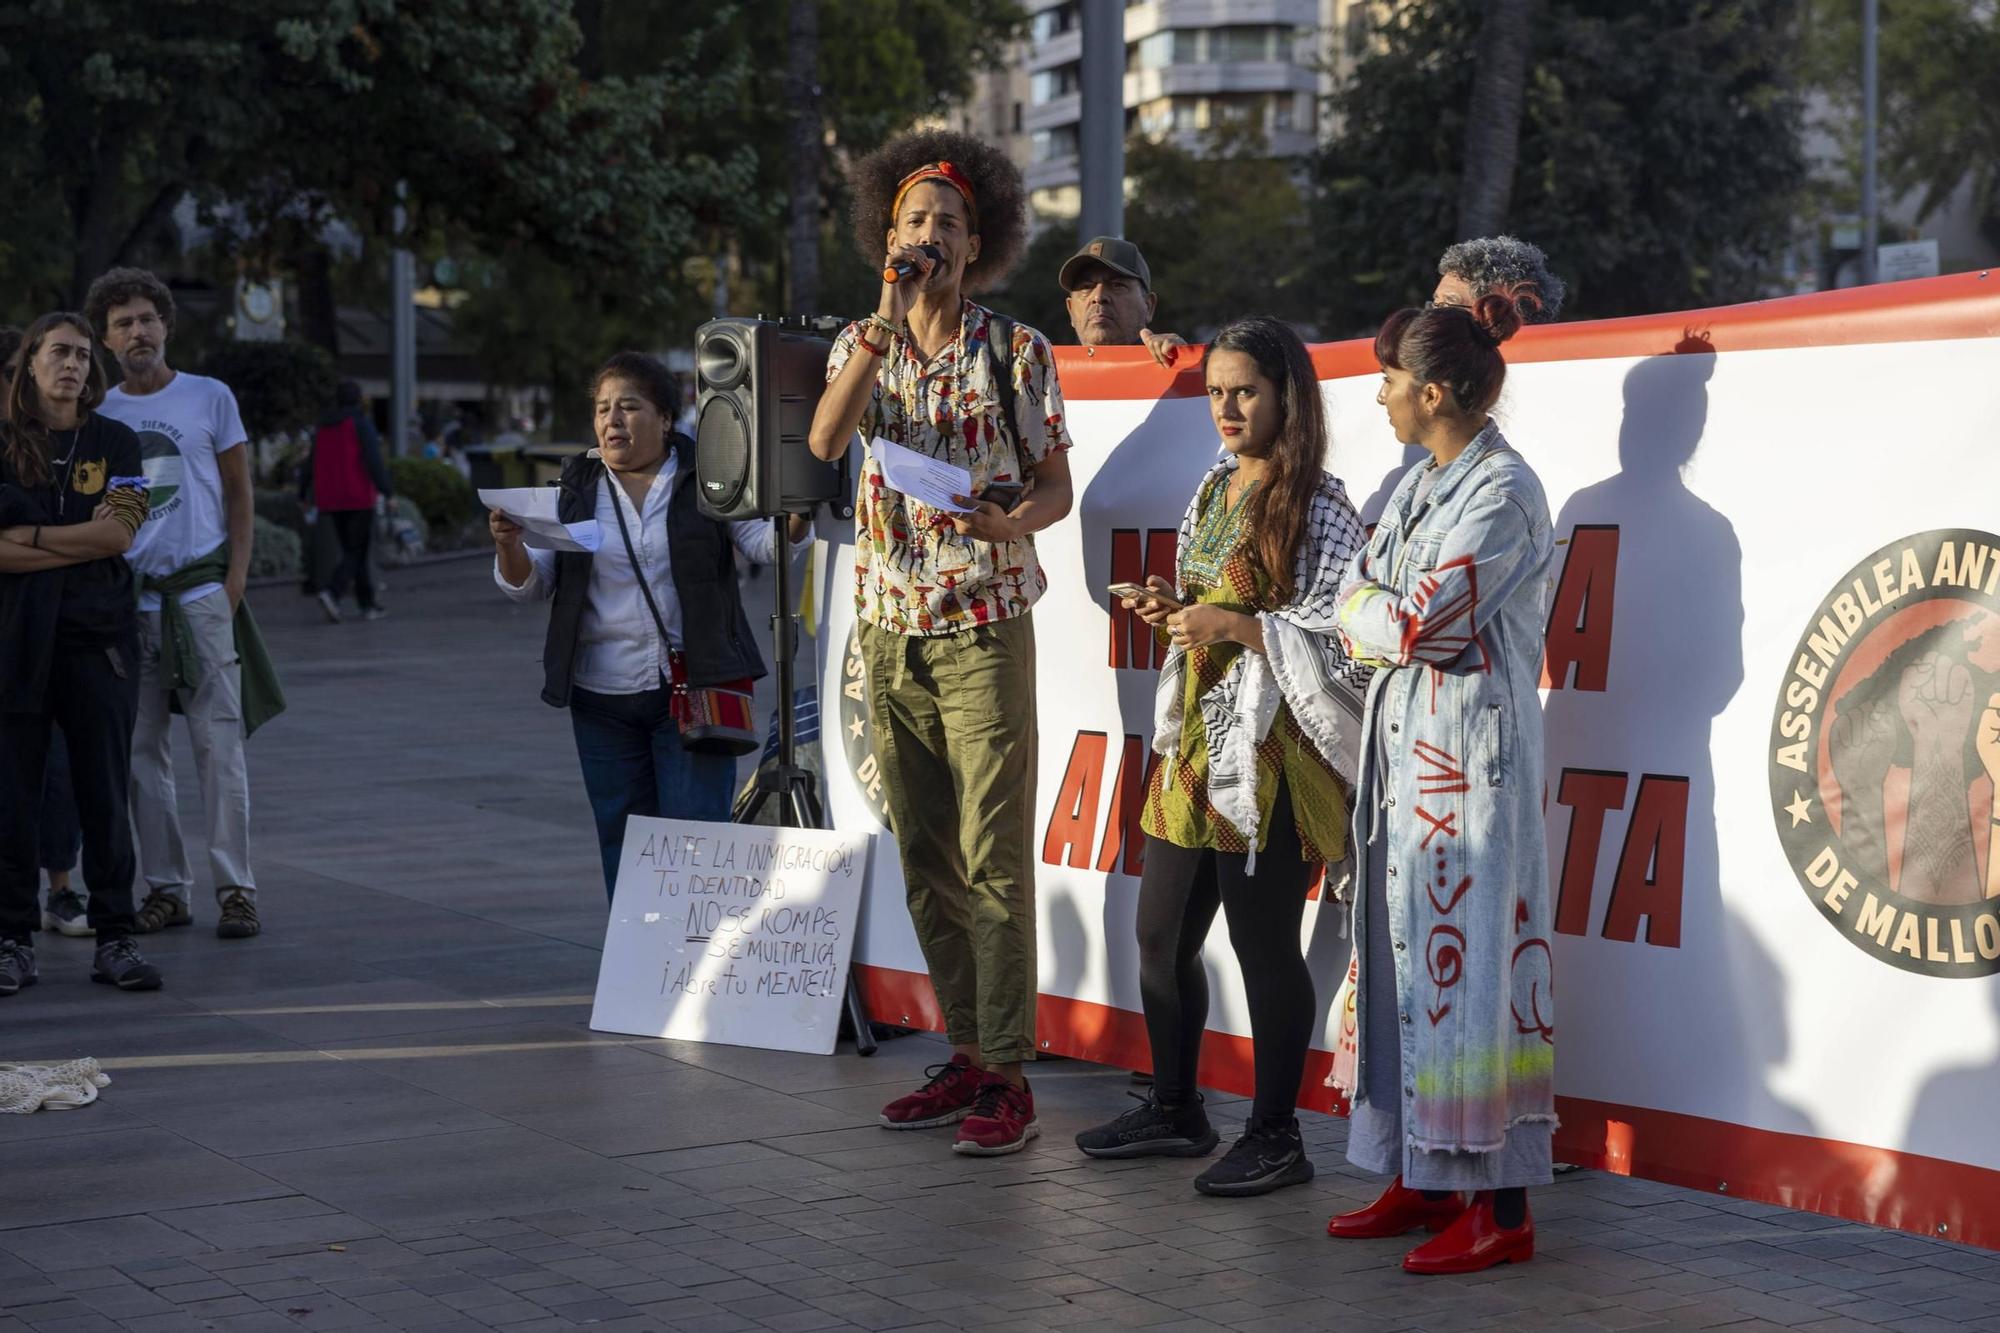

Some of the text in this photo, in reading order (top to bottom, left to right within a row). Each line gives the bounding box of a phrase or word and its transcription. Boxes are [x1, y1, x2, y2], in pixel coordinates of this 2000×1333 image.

[141, 420, 183, 442] SIEMPRE
[145, 497, 183, 521] LESTINA
[1776, 547, 1925, 772] ASSEMBLEA
[637, 833, 706, 867] ANTE
[712, 840, 735, 870] LA
[687, 874, 785, 900] IDENTIDAD
[1804, 845, 1859, 914] DE
[686, 900, 840, 940] NO SE ROMPE,
[707, 938, 742, 960] SE
[757, 967, 837, 997] MENTE!!
